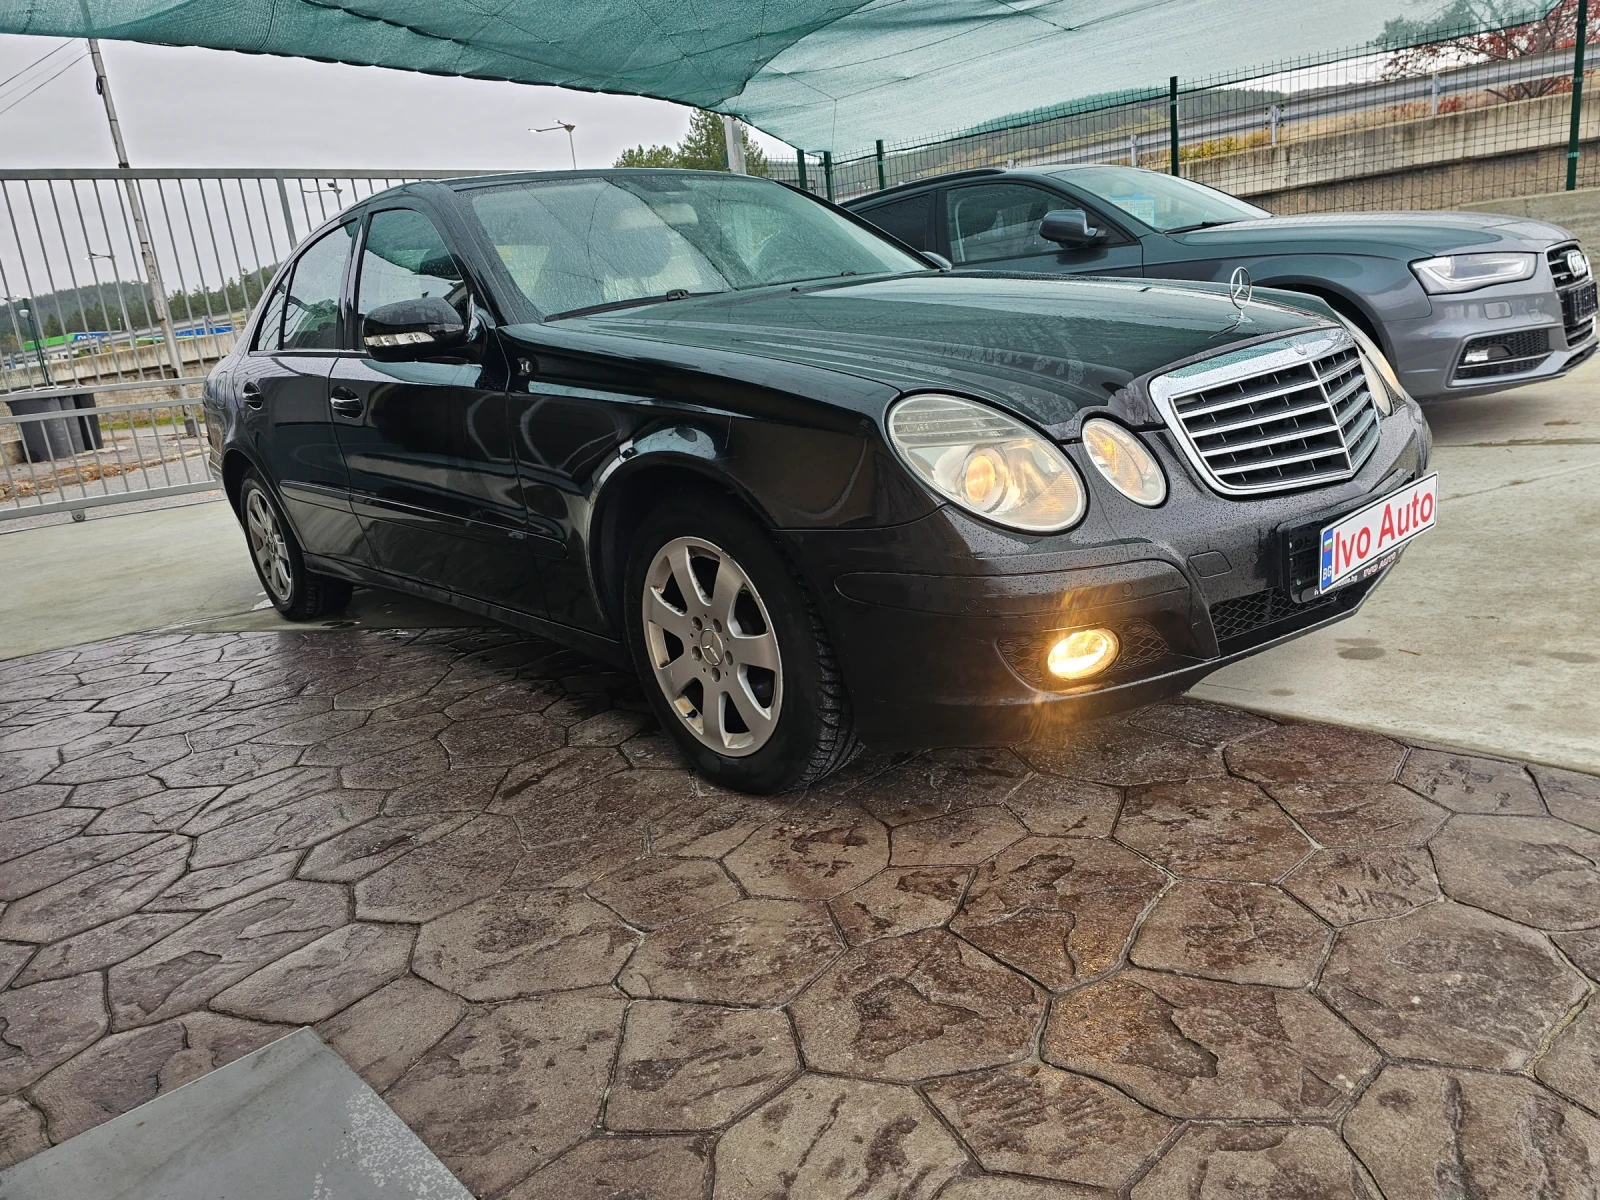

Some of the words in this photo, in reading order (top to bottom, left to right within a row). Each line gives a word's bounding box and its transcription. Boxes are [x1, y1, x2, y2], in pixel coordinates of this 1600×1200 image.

[1335, 526, 1371, 575] Ivo
[1377, 490, 1433, 548] Auto
[1322, 565, 1332, 580] BG
